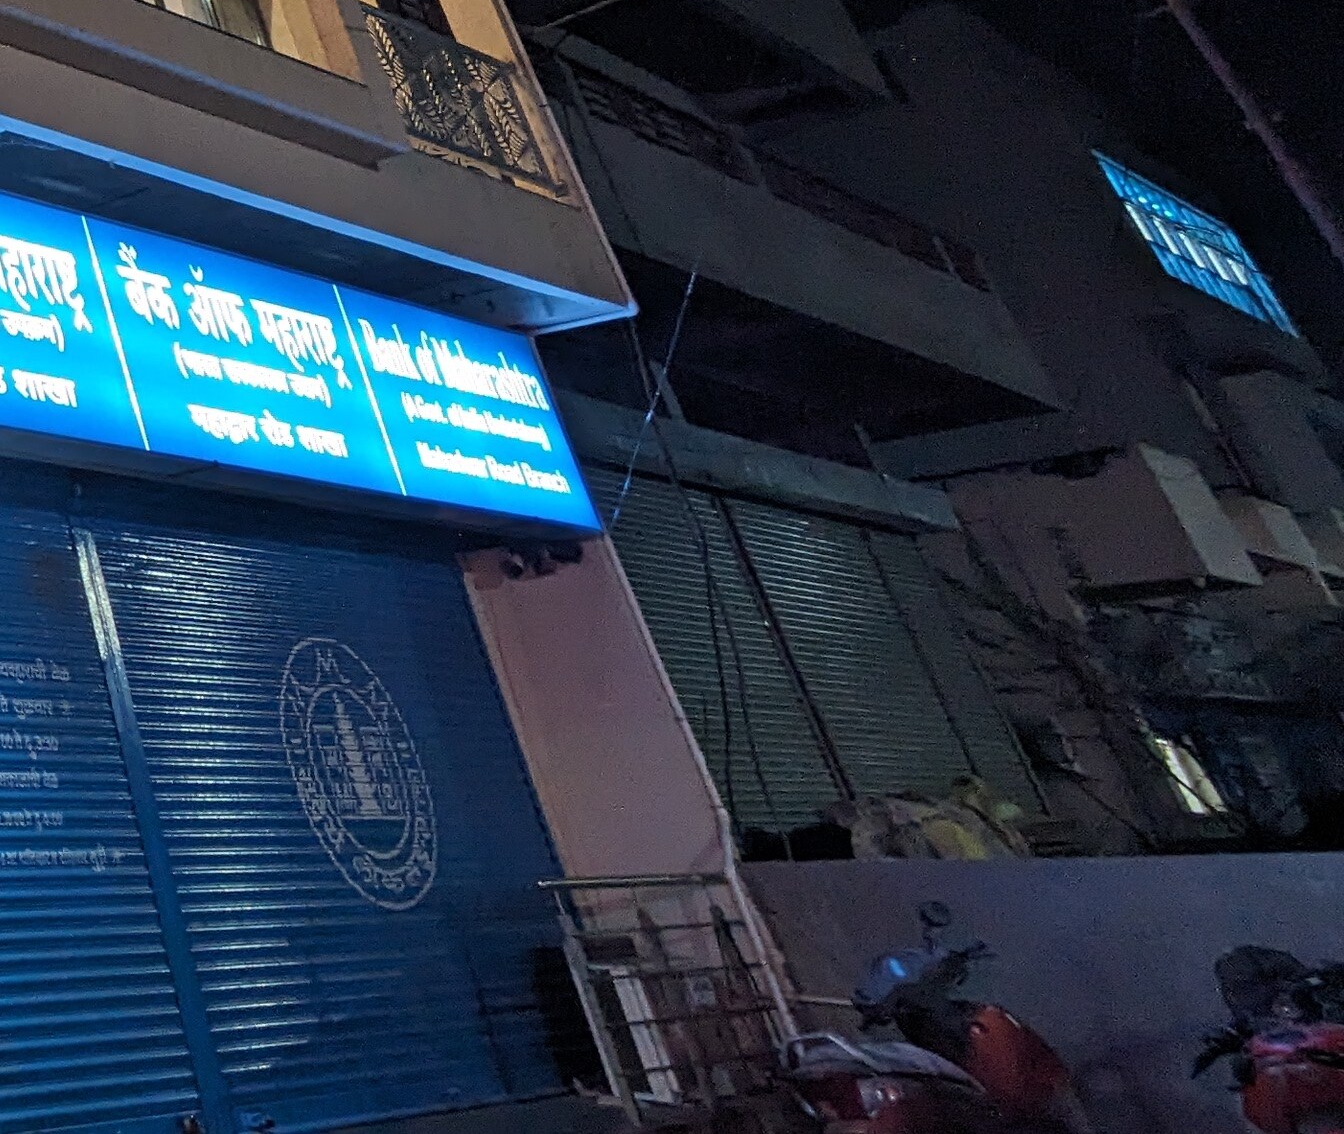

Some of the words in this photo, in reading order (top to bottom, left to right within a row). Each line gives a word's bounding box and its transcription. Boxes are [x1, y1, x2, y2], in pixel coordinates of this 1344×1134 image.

[183, 264, 253, 347] ऑफ
[250, 298, 353, 391] महाराष्ट्र
[12, 369, 77, 408] शाखा
[358, 318, 422, 381] Bank
[415, 330, 443, 386] of
[430, 336, 550, 411] Maharashtra
[519, 462, 572, 494] Branch
